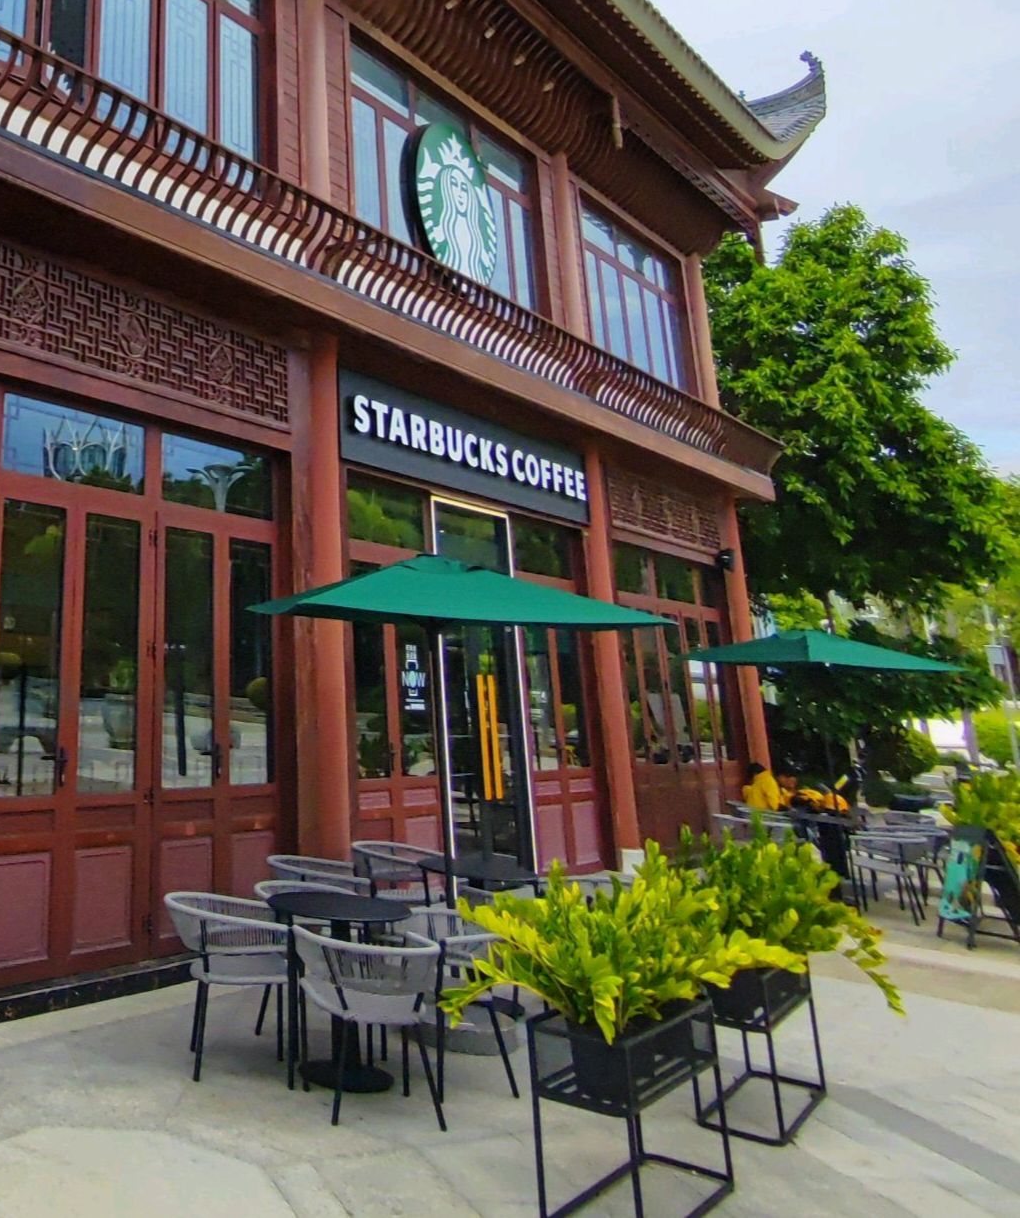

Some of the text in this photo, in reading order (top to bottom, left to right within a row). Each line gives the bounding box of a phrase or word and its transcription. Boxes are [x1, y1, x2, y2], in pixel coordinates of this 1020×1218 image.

[353, 394, 587, 501] STARBUCKS COFFEE
[401, 670, 426, 688] NOW
